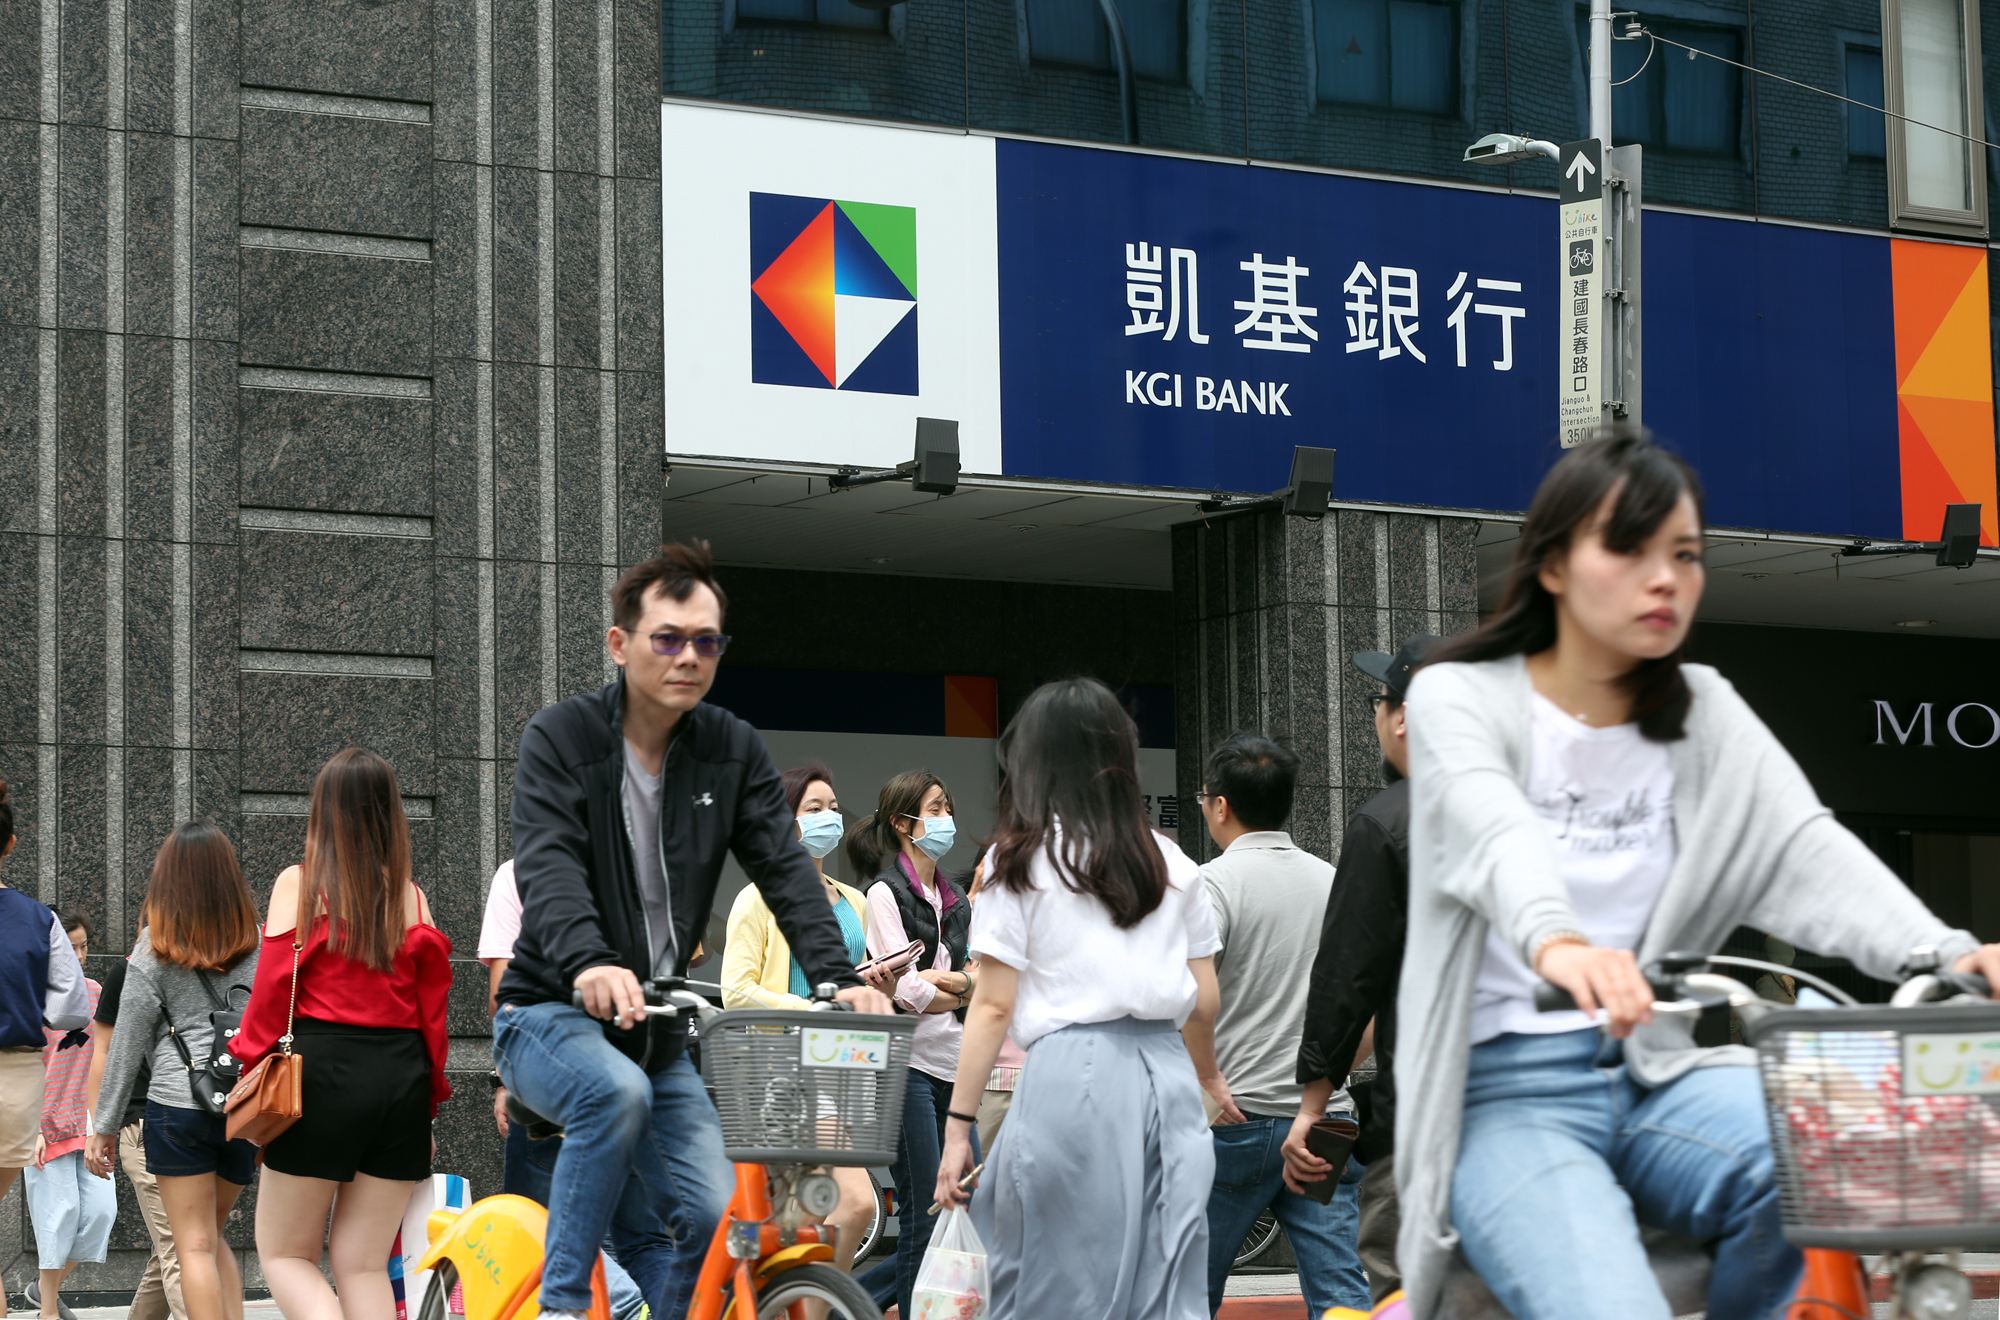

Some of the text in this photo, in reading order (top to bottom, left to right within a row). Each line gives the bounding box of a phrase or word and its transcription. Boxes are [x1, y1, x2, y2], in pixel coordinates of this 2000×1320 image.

[1565, 226, 1598, 239] 公共自行車
[1124, 241, 1526, 371] 凱基銀行
[1572, 279, 1590, 392] 建國長春路口
[1125, 369, 1292, 417] KGI BANK
[1561, 396, 1585, 406] Jianguo
[1560, 415, 1600, 427] Intersection
[1561, 405, 1594, 416] Changchun
[1567, 427, 1594, 443] 350M
[1873, 700, 2000, 748] MO
[1142, 794, 1178, 829] 富
